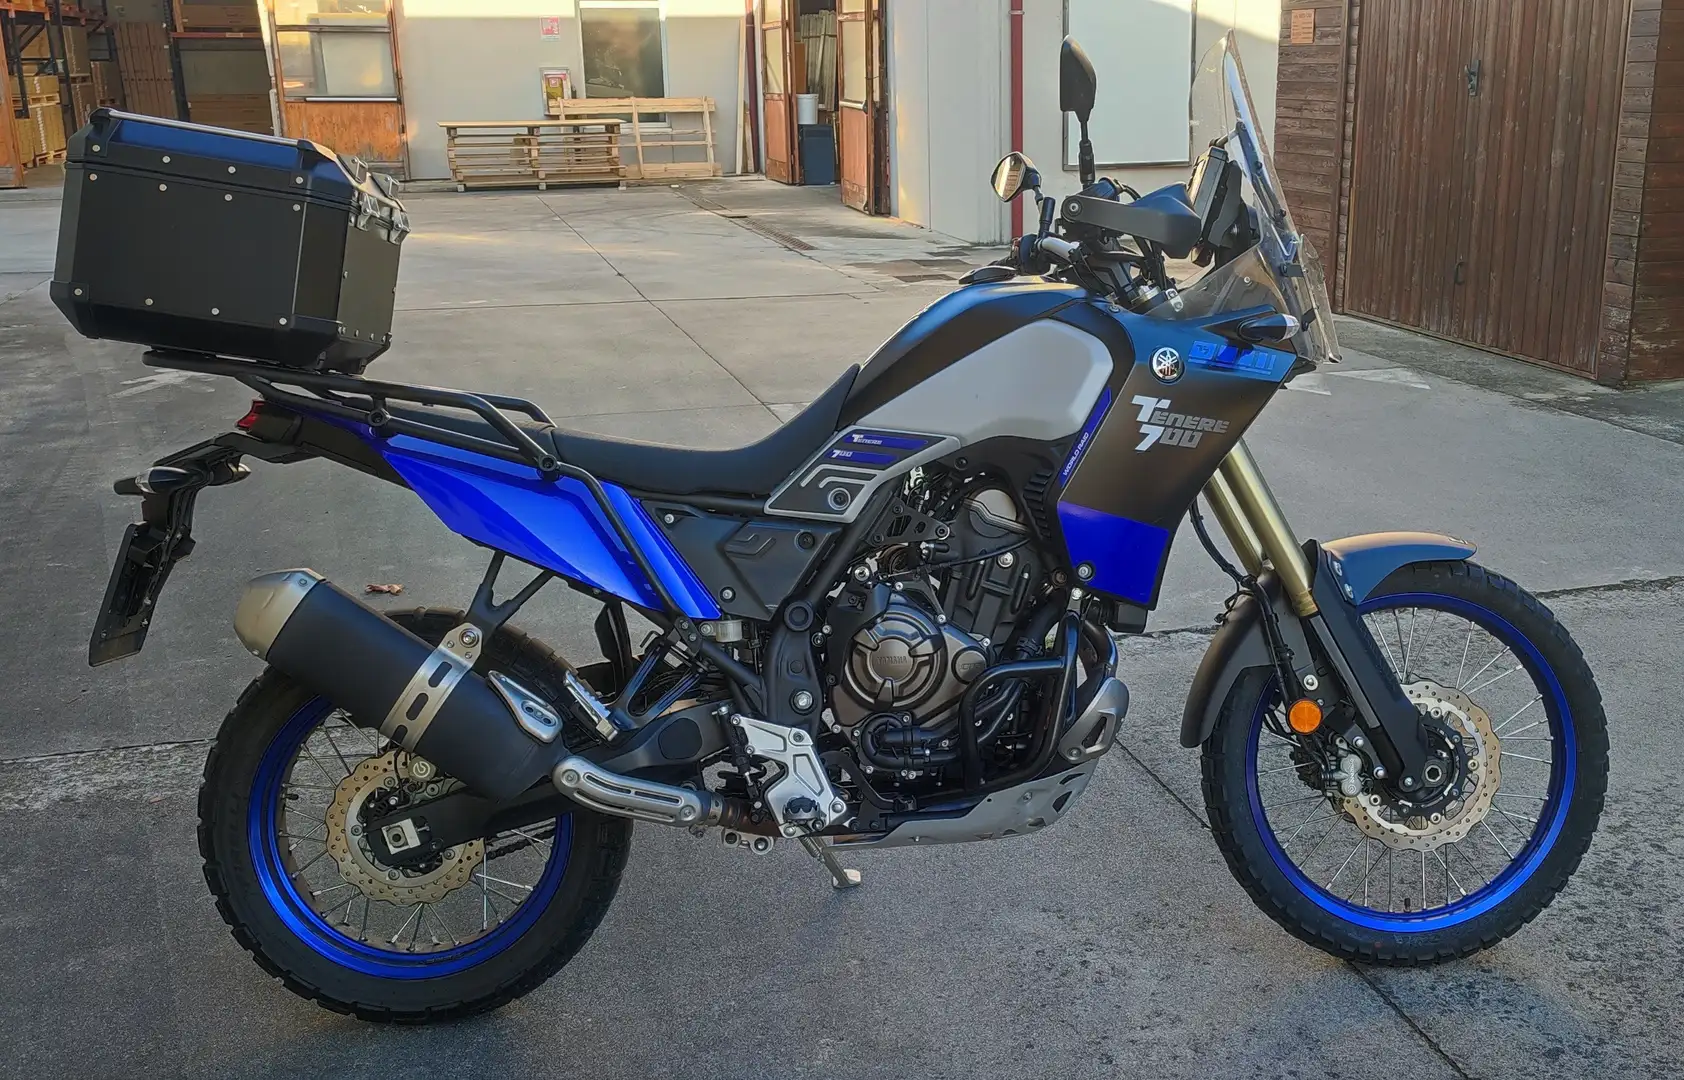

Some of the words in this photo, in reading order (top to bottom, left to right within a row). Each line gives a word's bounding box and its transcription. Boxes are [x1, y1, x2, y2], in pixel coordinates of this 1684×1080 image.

[1135, 424, 1203, 451] 700
[831, 449, 854, 458] 700
[1062, 449, 1080, 476] WORLD
[1077, 432, 1090, 451] RAID
